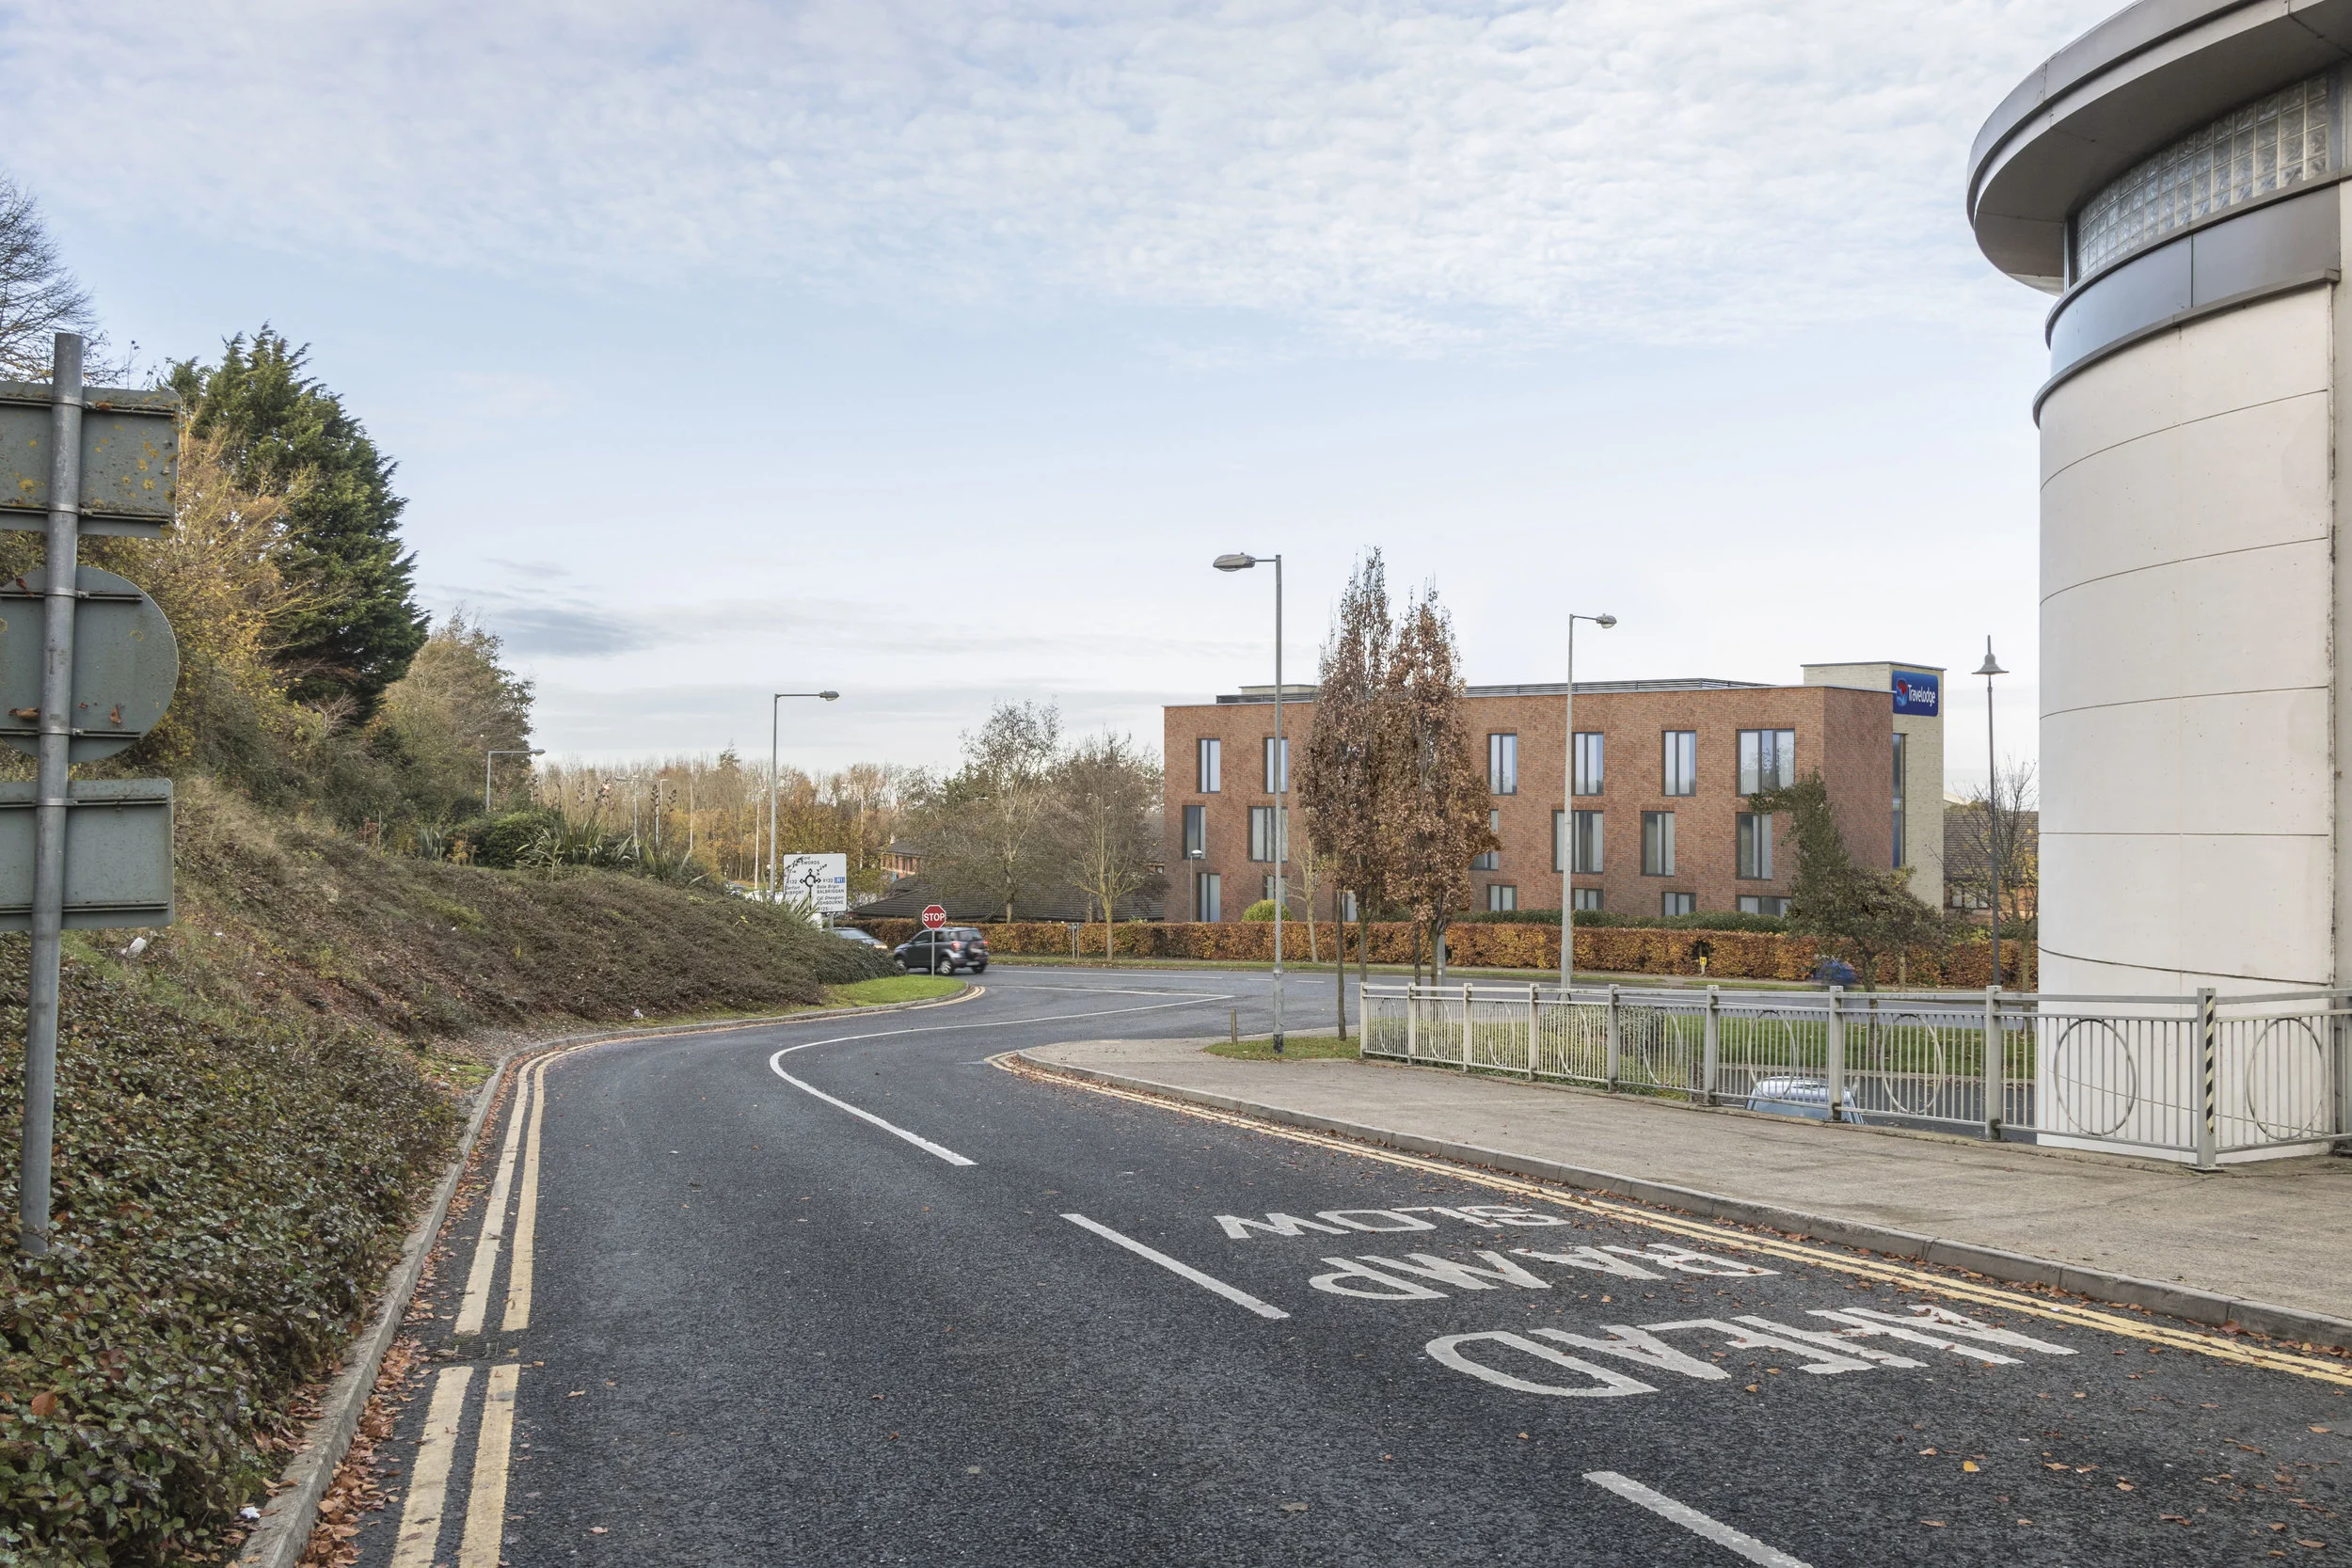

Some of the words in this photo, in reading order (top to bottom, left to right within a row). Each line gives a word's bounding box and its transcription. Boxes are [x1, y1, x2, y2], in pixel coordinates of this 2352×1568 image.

[1907, 685, 1936, 707] Travelodge
[924, 913, 945, 921] STOP
[1213, 1205, 1573, 1239] SLOW
[1309, 1243, 1783, 1300] RAMP
[1425, 1305, 2080, 1397] AHEAD
